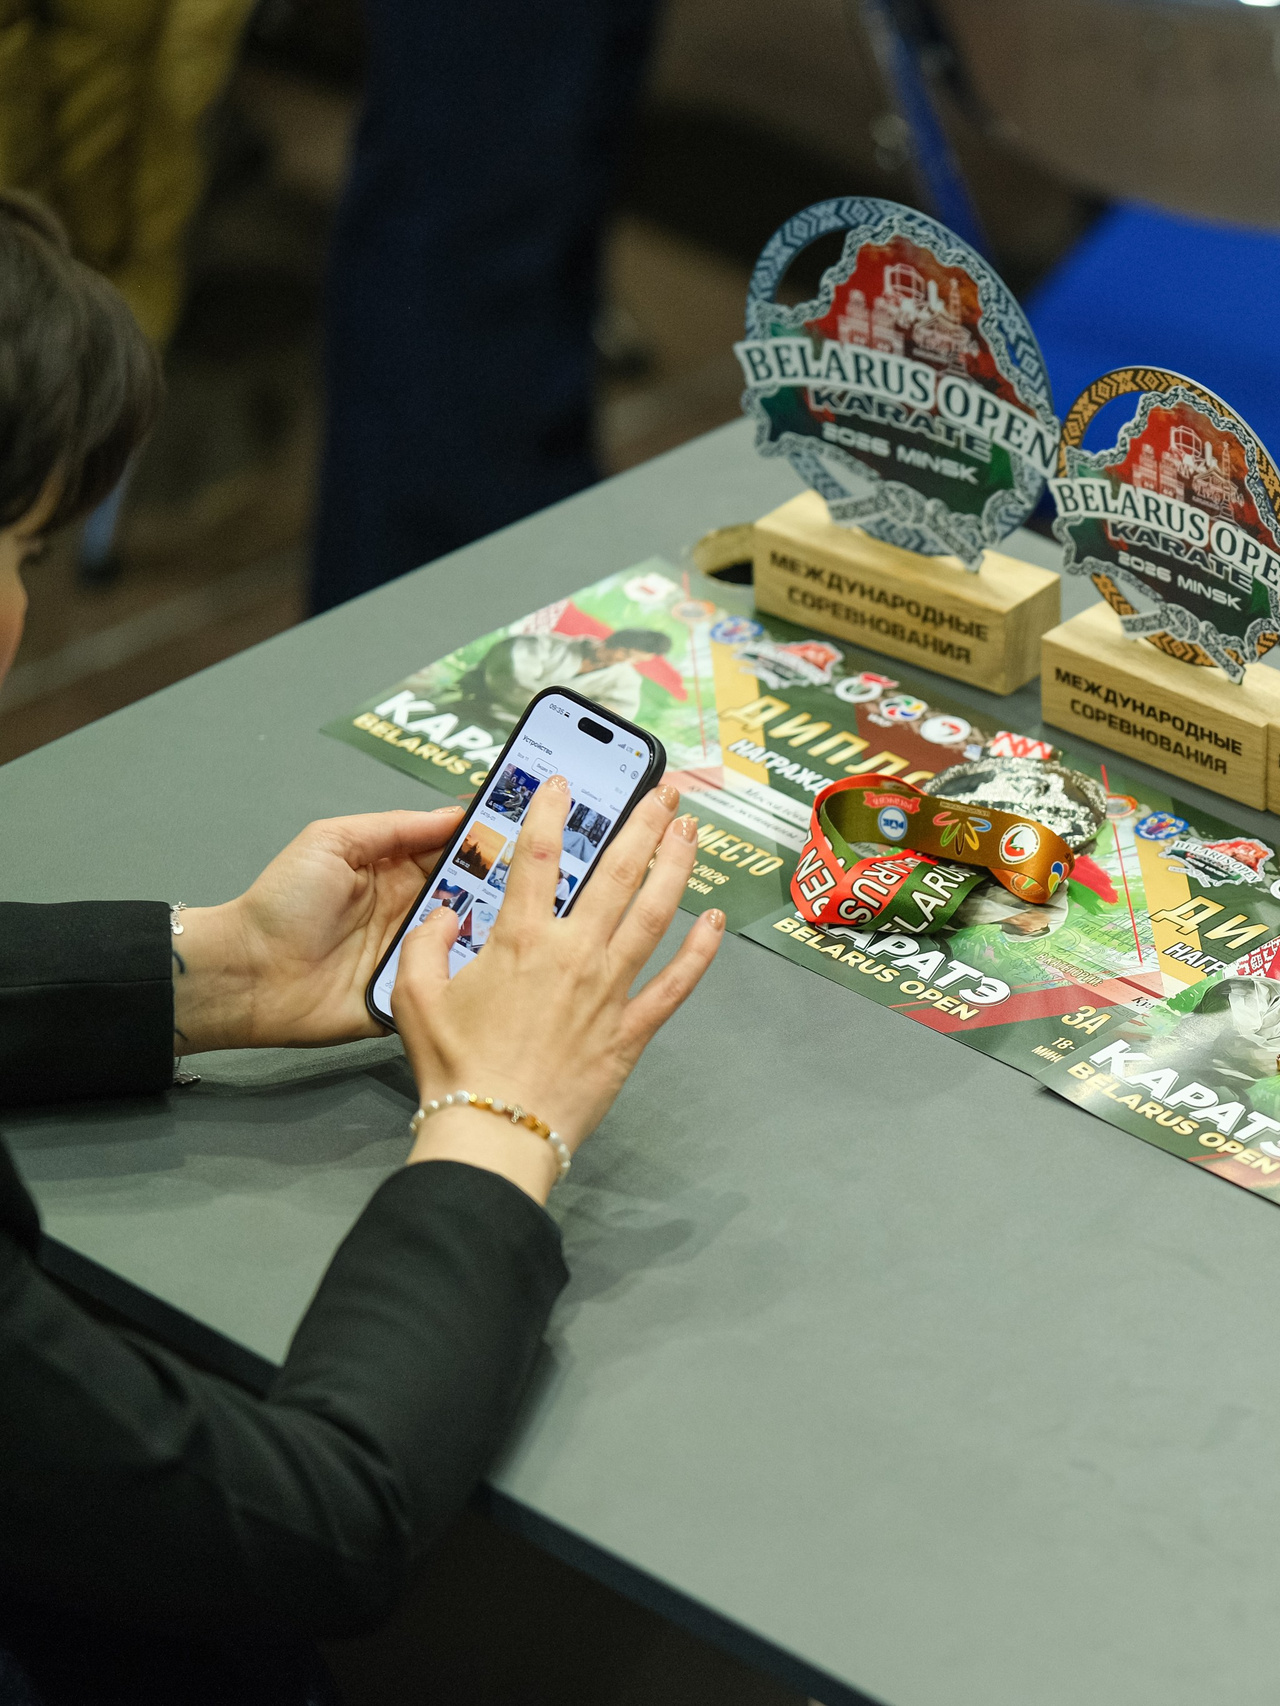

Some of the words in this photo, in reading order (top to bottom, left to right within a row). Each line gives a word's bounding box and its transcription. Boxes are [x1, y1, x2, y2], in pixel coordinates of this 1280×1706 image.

[743, 345, 933, 405] BELARUS
[944, 387, 1060, 468] OPEN
[814, 390, 993, 463] KARATE
[821, 424, 891, 456] 2026
[897, 446, 980, 485] MINSK
[1054, 482, 1210, 542] BELARUS
[1110, 521, 1254, 594] KARATE
[1117, 551, 1172, 583] 2026
[1177, 573, 1242, 611] MINSK
[770, 551, 989, 642] МЕЖДУНАРОДНЫЕ
[788, 587, 971, 665] СОРЕВНОВАНИЯ
[352, 713, 473, 777] BELARUS
[374, 690, 499, 770] КАРА
[1055, 667, 1242, 756] МЕЖДУНАРОДНЫЕ
[1070, 699, 1227, 775] СОРЕВНОВАНИЯ
[698, 823, 784, 877] МЕСТО
[772, 917, 901, 983] BELARUS
[899, 980, 981, 1022] OPEN
[794, 909, 1013, 1007] АРАТЭ
[1051, 1037, 1076, 1050] 18-
[1066, 1060, 1202, 1137] BELARUS
